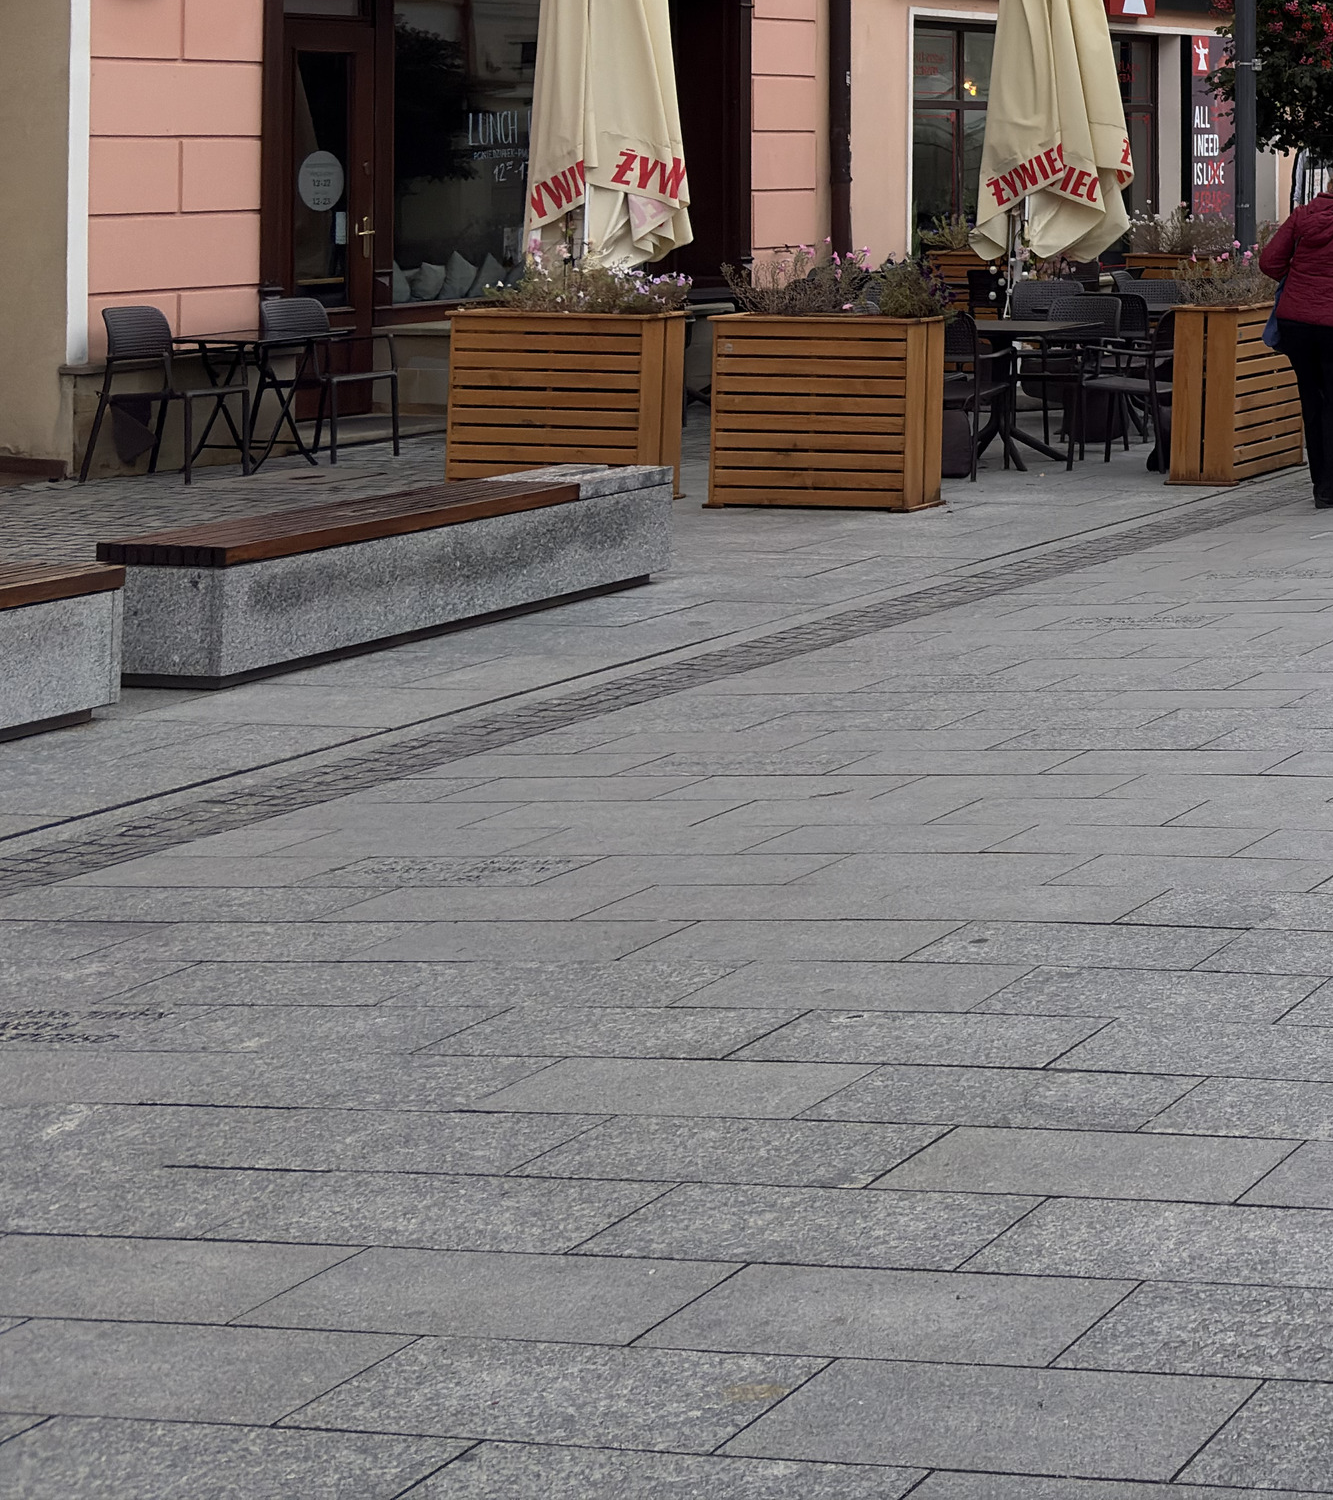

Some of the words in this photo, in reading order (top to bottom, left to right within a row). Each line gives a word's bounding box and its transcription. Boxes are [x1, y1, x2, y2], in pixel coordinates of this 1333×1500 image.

[468, 110, 518, 146] LUNCH
[1194, 105, 1211, 128] ALL
[1197, 134, 1219, 157] NEED
[1194, 163, 1203, 185] IS
